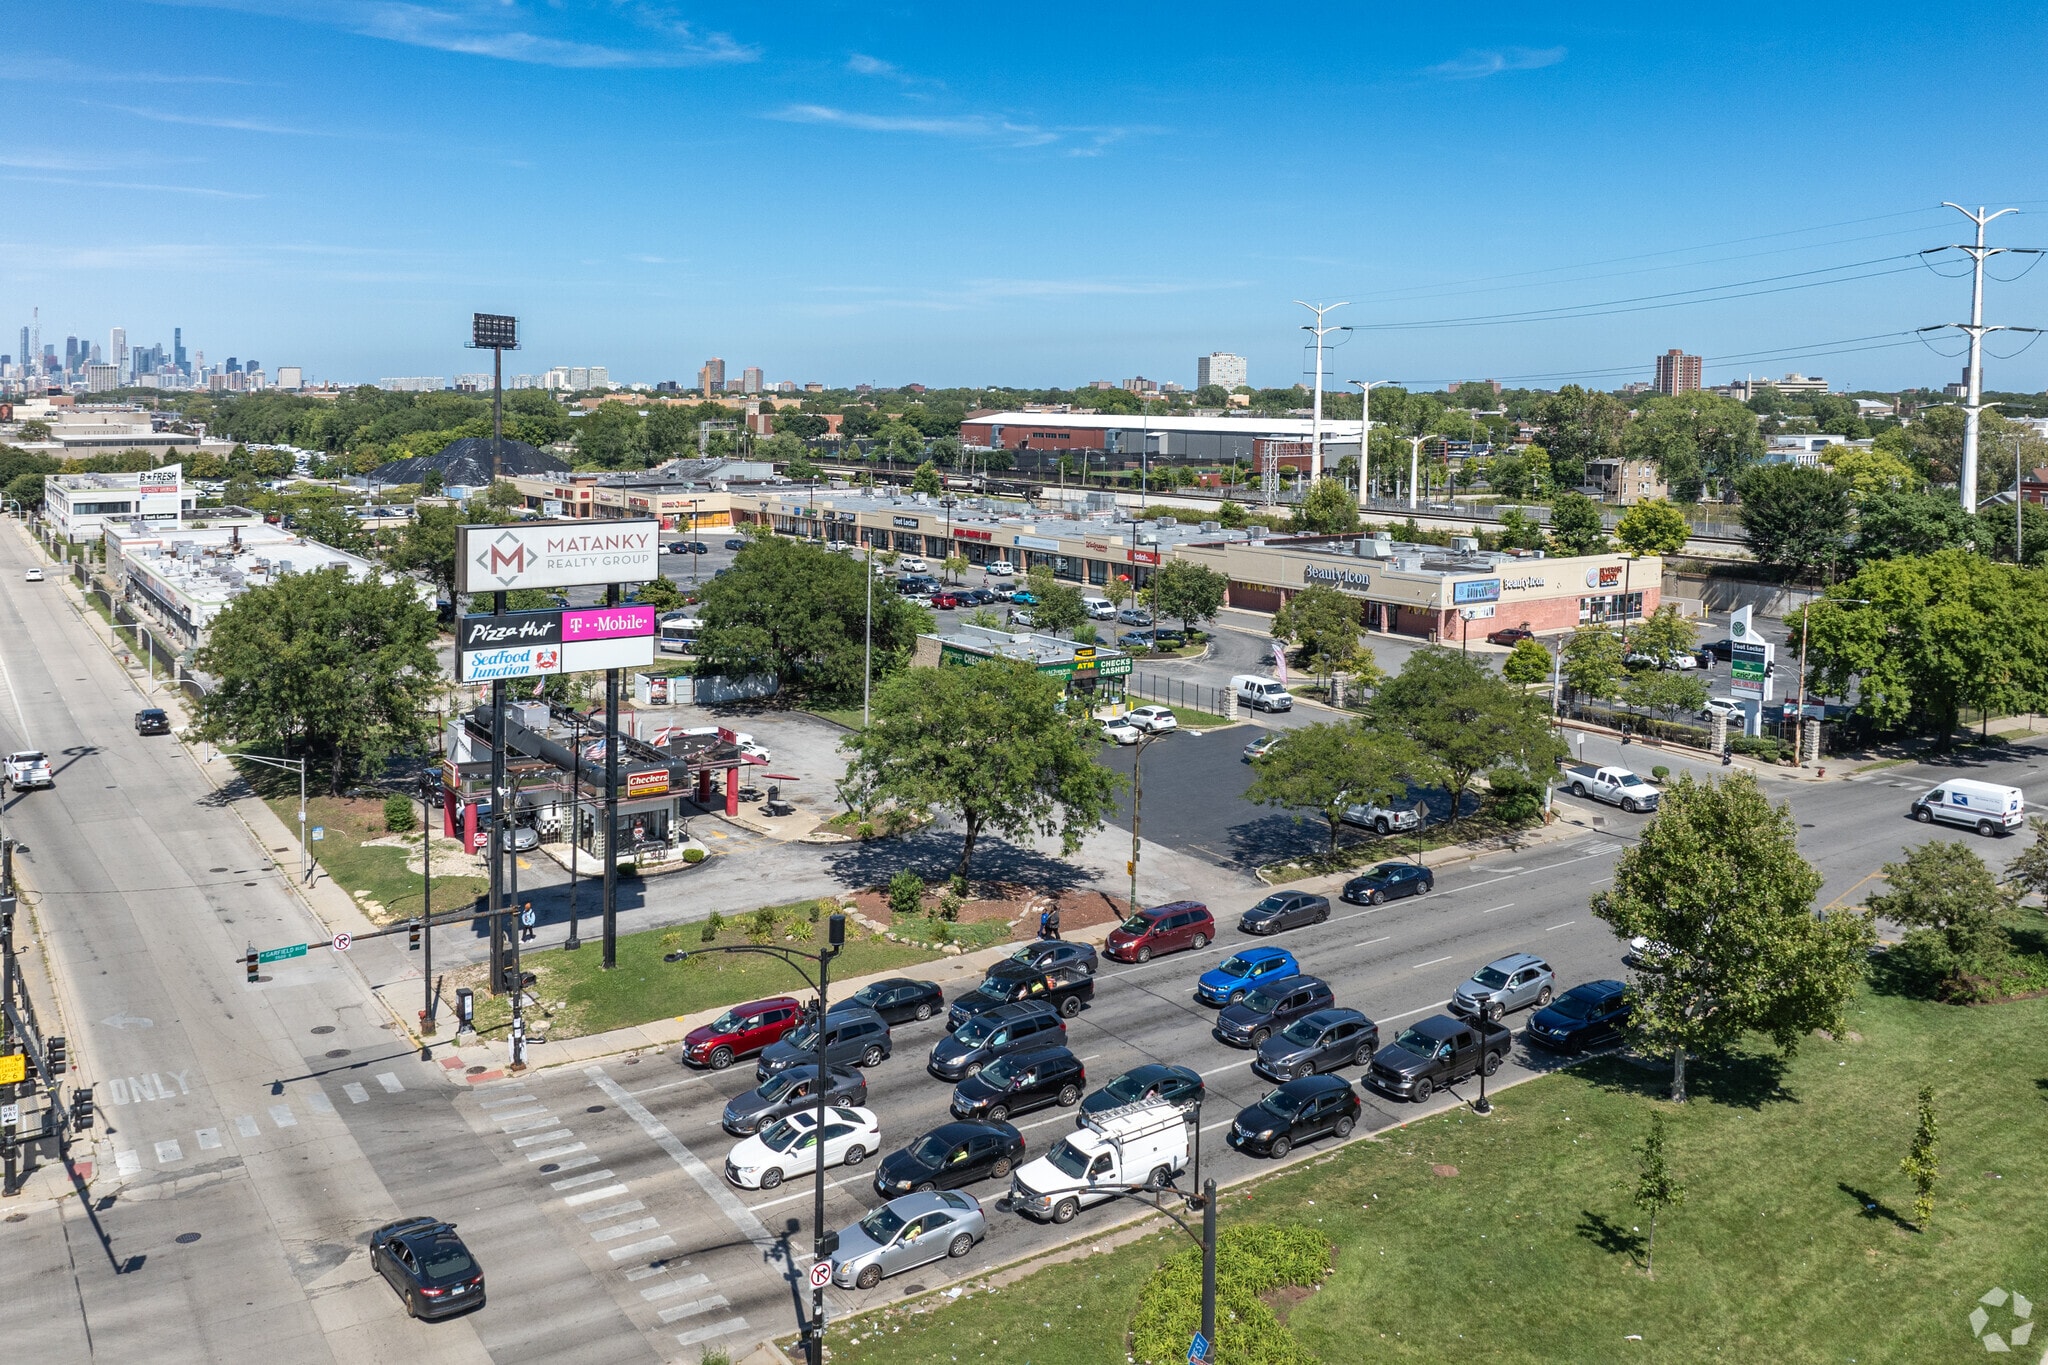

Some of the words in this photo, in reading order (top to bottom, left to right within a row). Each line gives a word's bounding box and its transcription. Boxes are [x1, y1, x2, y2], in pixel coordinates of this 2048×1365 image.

[894, 517, 903, 526] Foot
[903, 519, 918, 528] Locker
[547, 533, 649, 553] MATANKY
[547, 557, 597, 569] REALTY
[602, 554, 649, 566] GROUP
[1305, 563, 1342, 584] Beauty
[1342, 571, 1370, 585] Icon
[1503, 577, 1529, 591] Beauty
[1528, 576, 1545, 588] Icon
[468, 623, 518, 644] Pizza
[518, 620, 555, 638] Hut
[1077, 662, 1094, 670] ATM
[1100, 658, 1131, 668] CHECKS
[467, 664, 530, 680] Junction
[1100, 666, 1131, 675] CASHED
[630, 774, 668, 786] Checkers
[266, 946, 295, 958] GARFIELD
[294, 944, 306, 952] BLVD
[109, 1069, 189, 1105] ONLY
[3, 1105, 16, 1113] ONE
